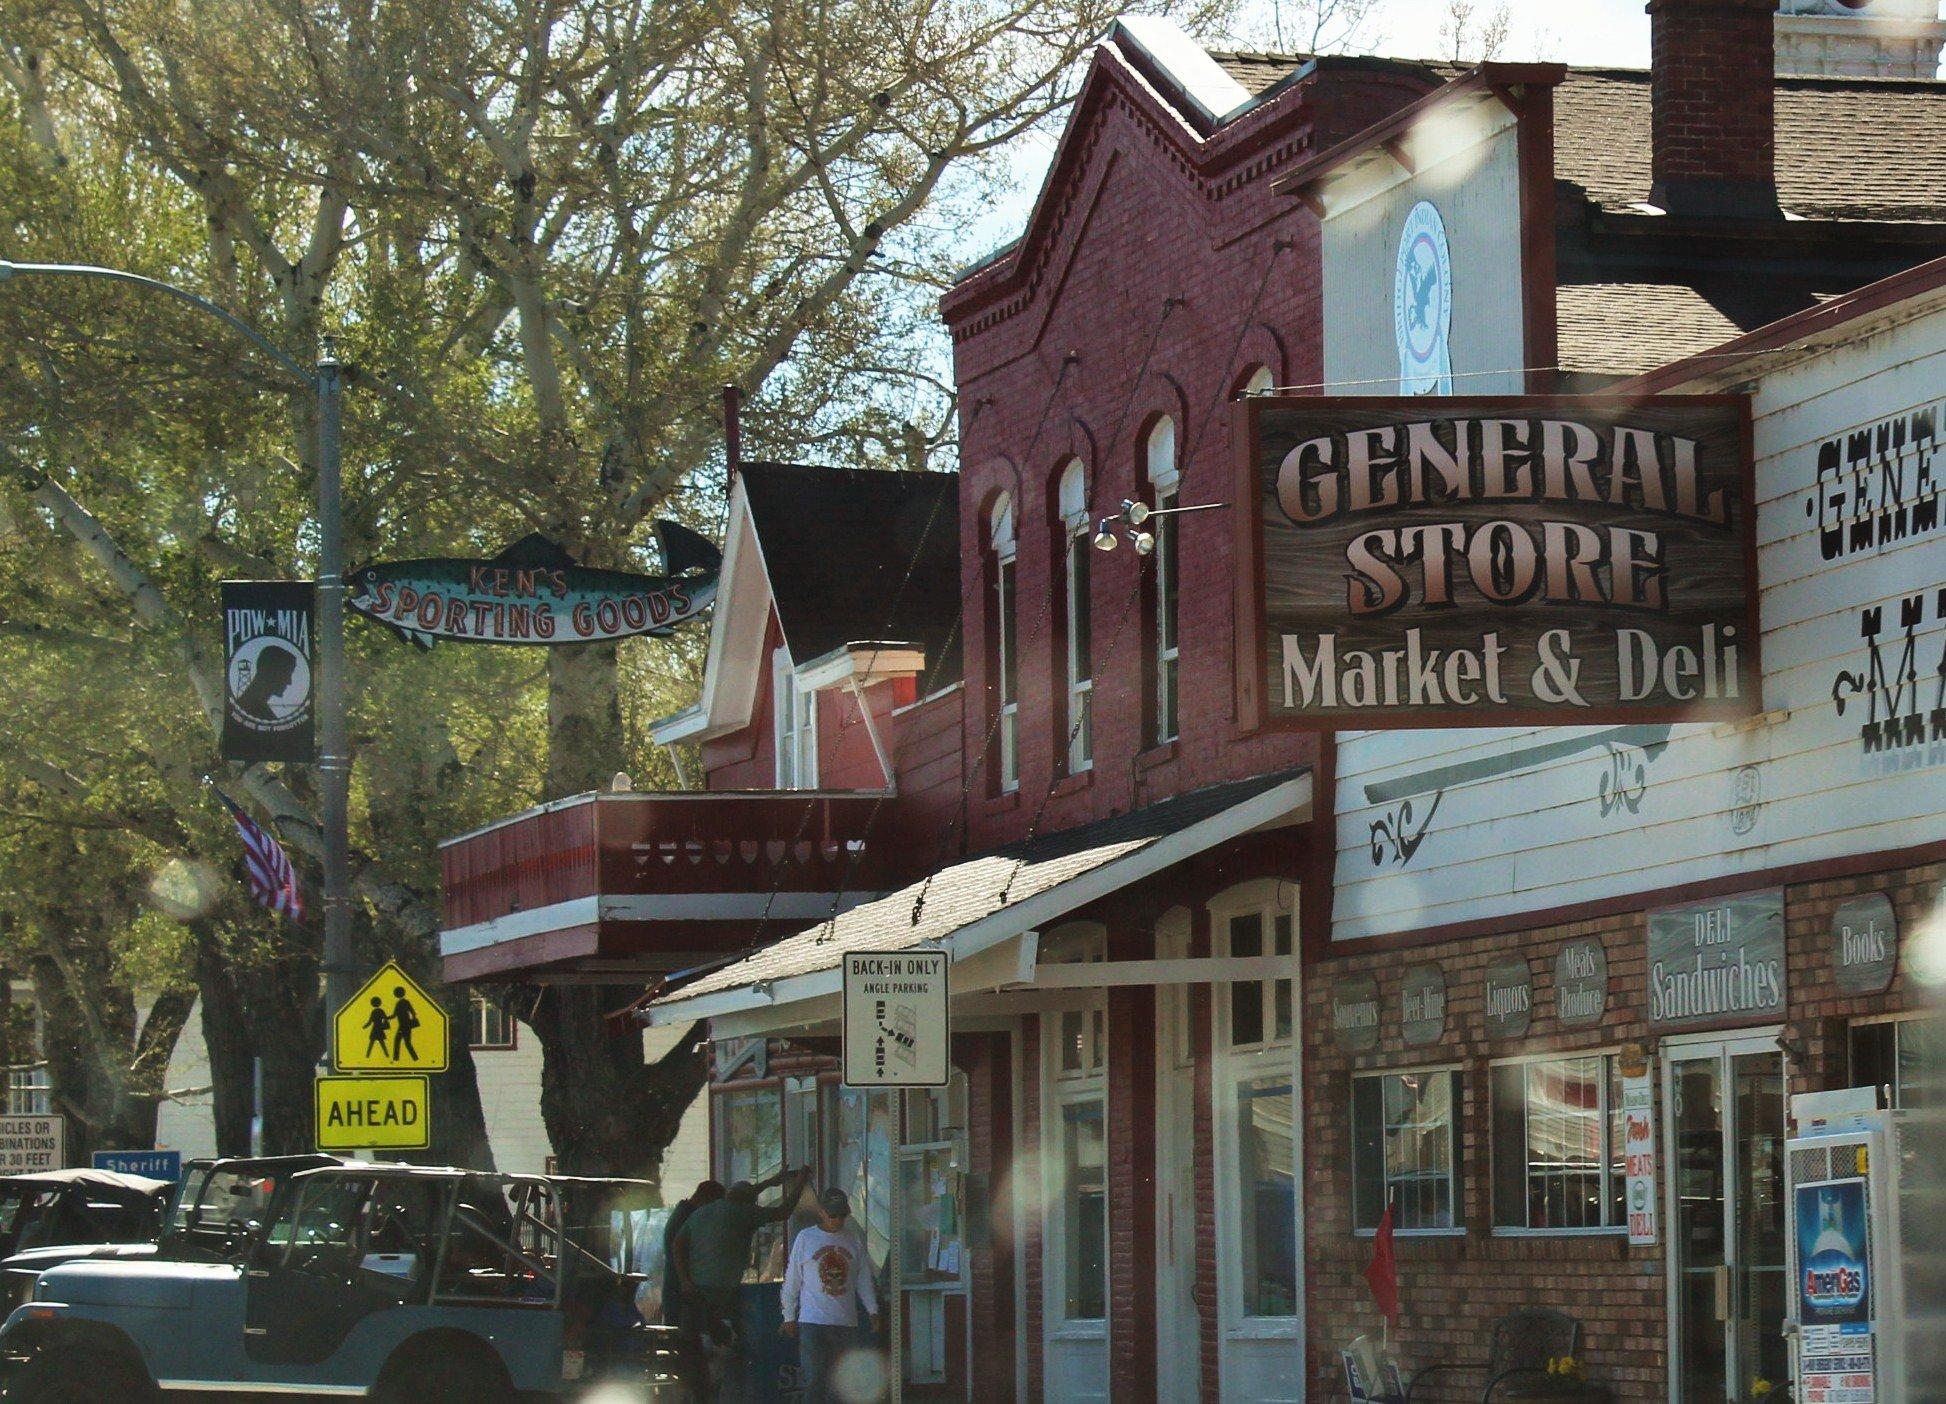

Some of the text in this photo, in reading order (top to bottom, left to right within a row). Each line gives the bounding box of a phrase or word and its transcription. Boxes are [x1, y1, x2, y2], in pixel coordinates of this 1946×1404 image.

[1276, 418, 1728, 525] GENERAL
[1818, 404, 1946, 562] GENE
[467, 566, 569, 598] KEN'S
[1345, 520, 1666, 615] STORE
[370, 581, 693, 639] SPORTING GOODS
[227, 609, 310, 660] POW MIA
[1280, 623, 1740, 709] Market & Deli
[1861, 587, 1946, 754] M
[1694, 907, 1731, 947] DELI
[1842, 920, 1885, 967] Books
[853, 960, 939, 975] BACK-IN ONLY
[1566, 944, 1595, 979] Meats
[863, 983, 928, 994] ANGLE PARKING
[1487, 980, 1530, 1023] Liquors
[1561, 982, 1601, 1018] Produce
[1652, 946, 1780, 1021] Sandwiches
[0, 1121, 50, 1134] ICLES OR
[327, 1100, 418, 1127] AHEAD
[26, 1153, 51, 1166] FEET
[106, 1158, 169, 1172] Sheriff
[1626, 1154, 1654, 1177] MEATS
[1629, 1213, 1654, 1236] DELI
[1805, 1267, 1862, 1295] AmeriGas
